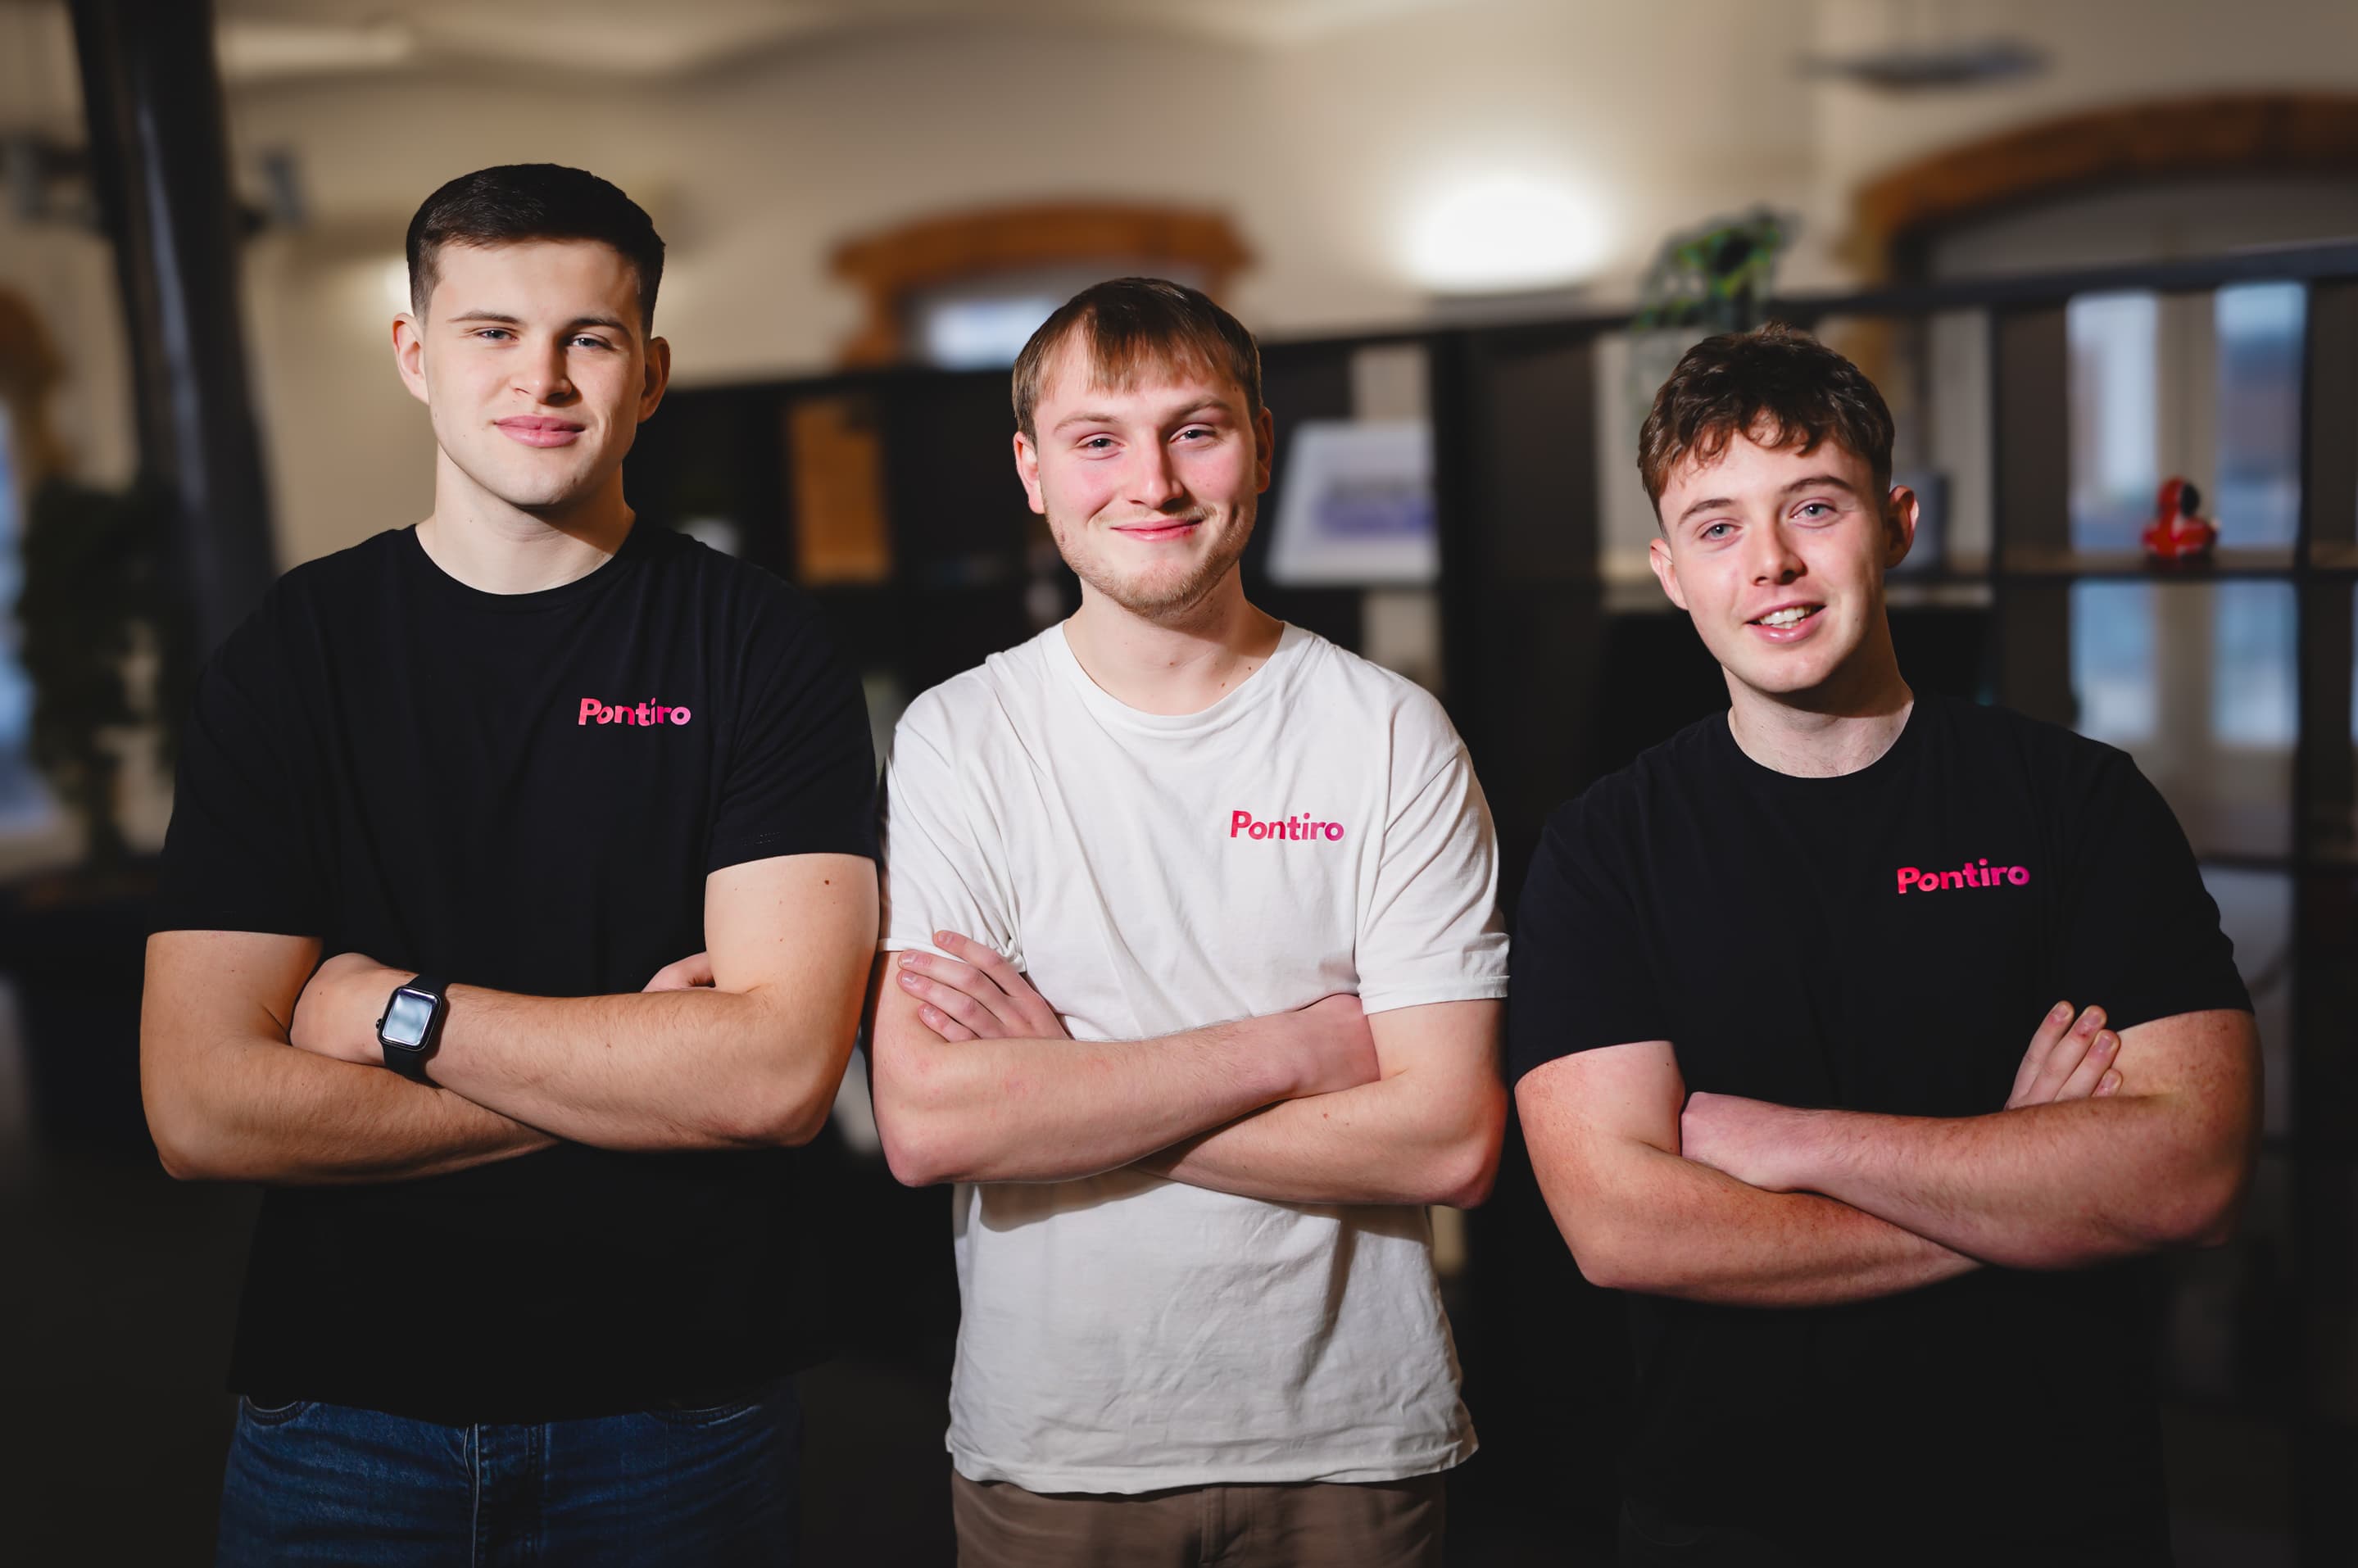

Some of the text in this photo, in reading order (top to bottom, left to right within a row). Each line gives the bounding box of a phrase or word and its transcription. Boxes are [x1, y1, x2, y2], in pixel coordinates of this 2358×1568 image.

[578, 697, 692, 727] Pontiro
[1230, 809, 1345, 842] Pontiro
[1896, 857, 2031, 895] Pontiro
